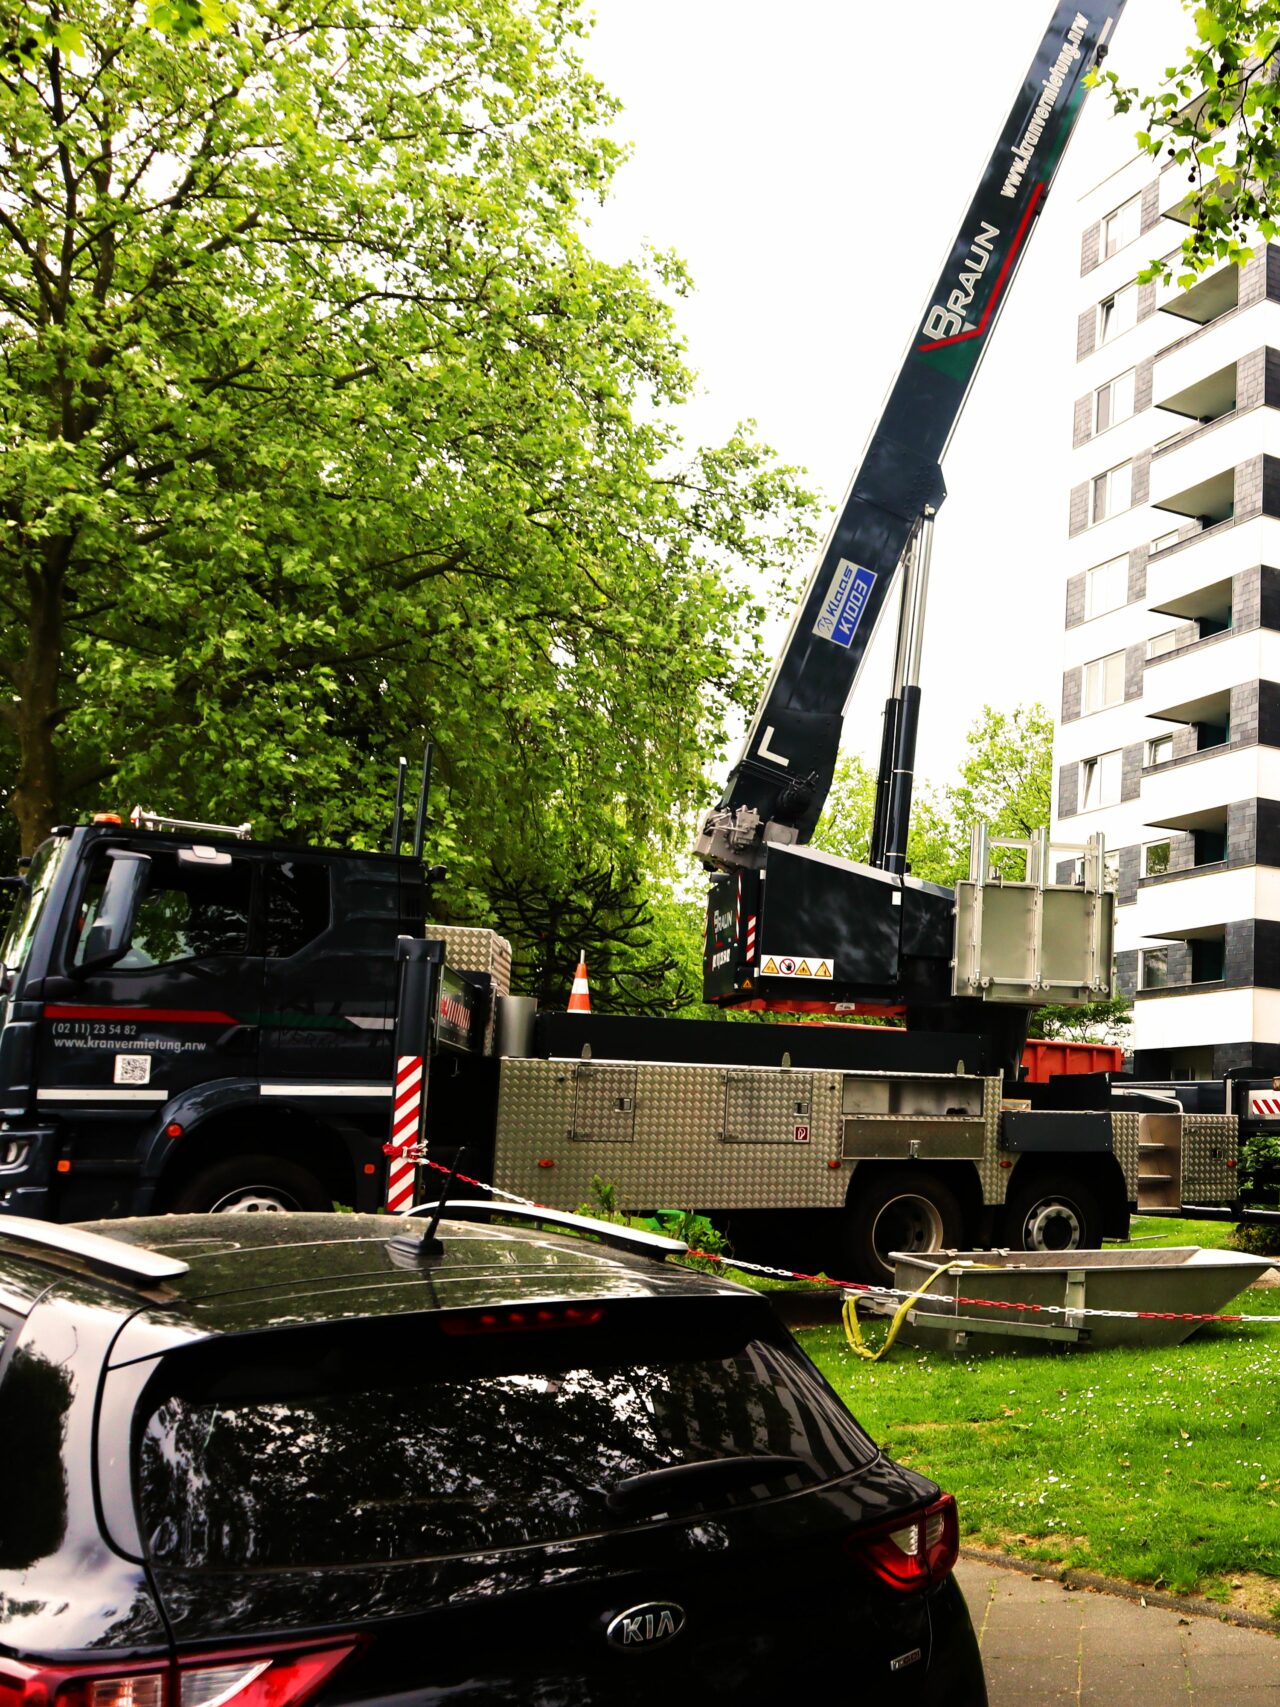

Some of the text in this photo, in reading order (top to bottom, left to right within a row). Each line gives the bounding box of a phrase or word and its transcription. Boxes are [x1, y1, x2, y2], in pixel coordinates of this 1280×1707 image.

[1000, 11, 1089, 199] www.kranvermietung.nrw
[922, 220, 1001, 341] BRAUN
[826, 565, 853, 618] Klaas
[838, 579, 868, 635] K1003
[53, 1036, 208, 1053] www.kranvermietung.nrw
[74, 1023, 91, 1036] 11)
[93, 1025, 106, 1035] 23
[108, 1025, 122, 1035] 54
[124, 1025, 137, 1035] 82
[622, 1611, 675, 1644] KIA
